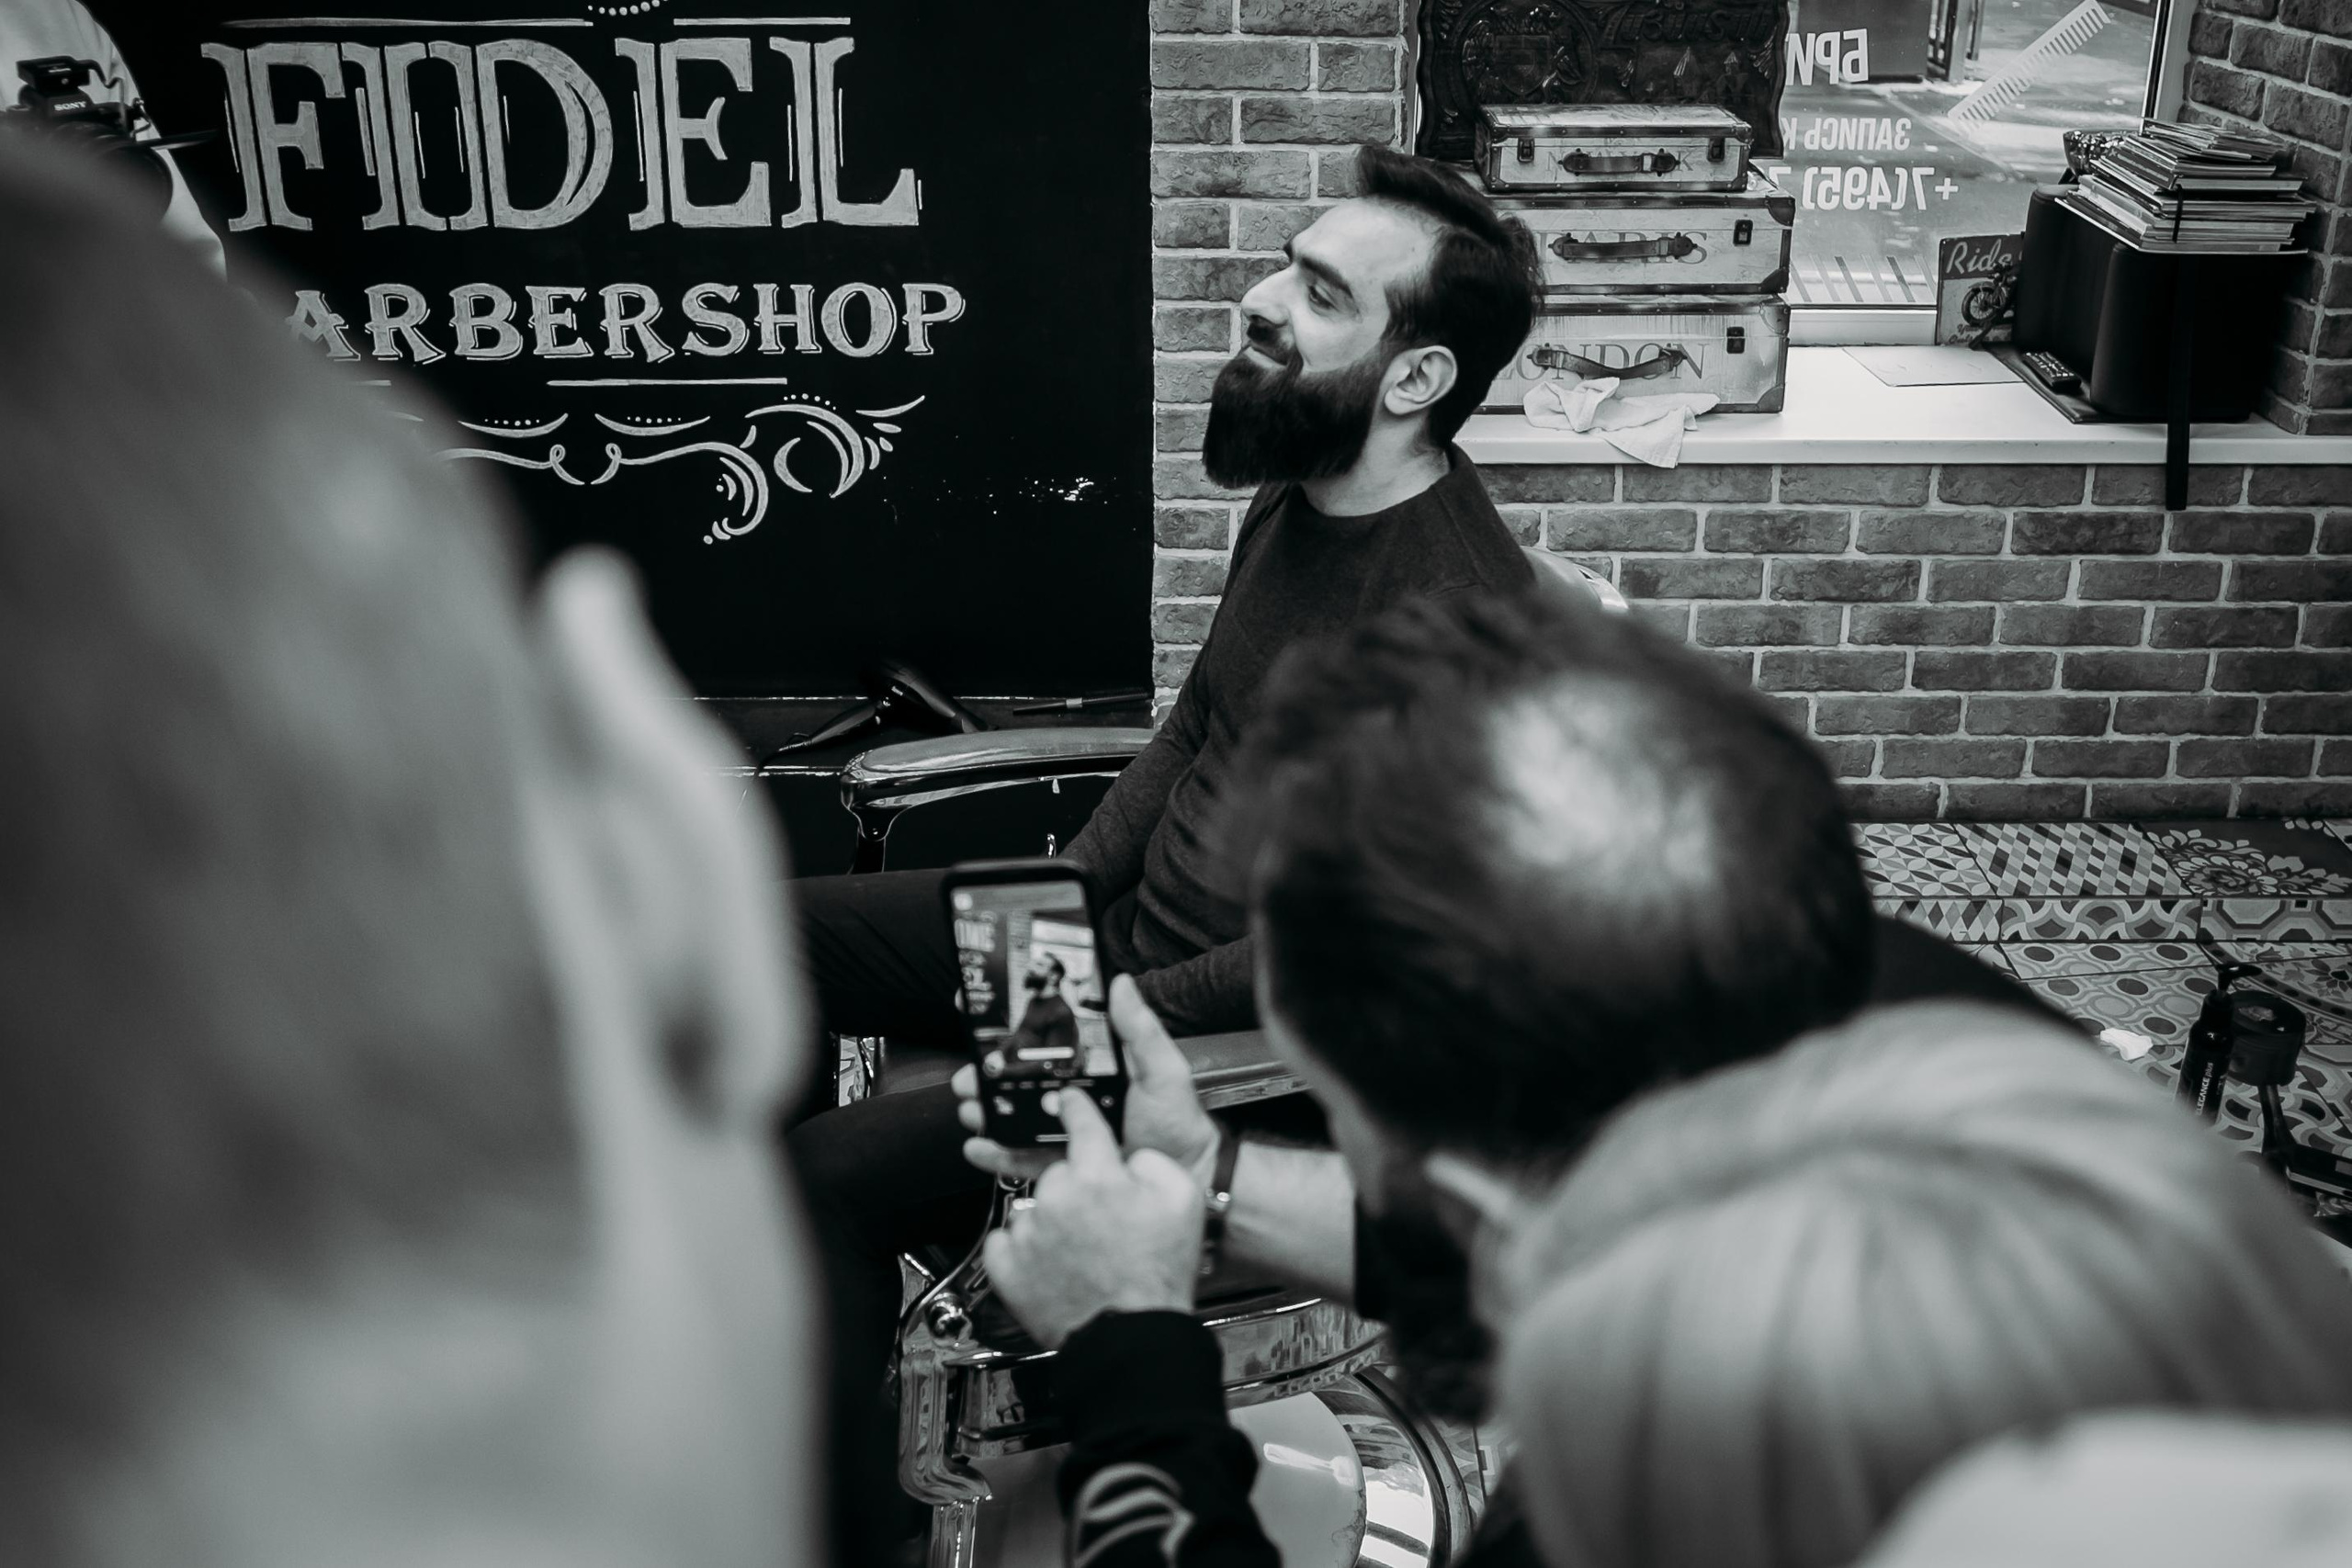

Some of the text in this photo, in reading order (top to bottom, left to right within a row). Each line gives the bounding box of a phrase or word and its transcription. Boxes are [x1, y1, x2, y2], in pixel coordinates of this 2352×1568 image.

[53, 101, 86, 111] SONY
[199, 37, 920, 231] FIDEL
[1946, 238, 2013, 274] Ride
[285, 282, 966, 364] ARBERSHOP
